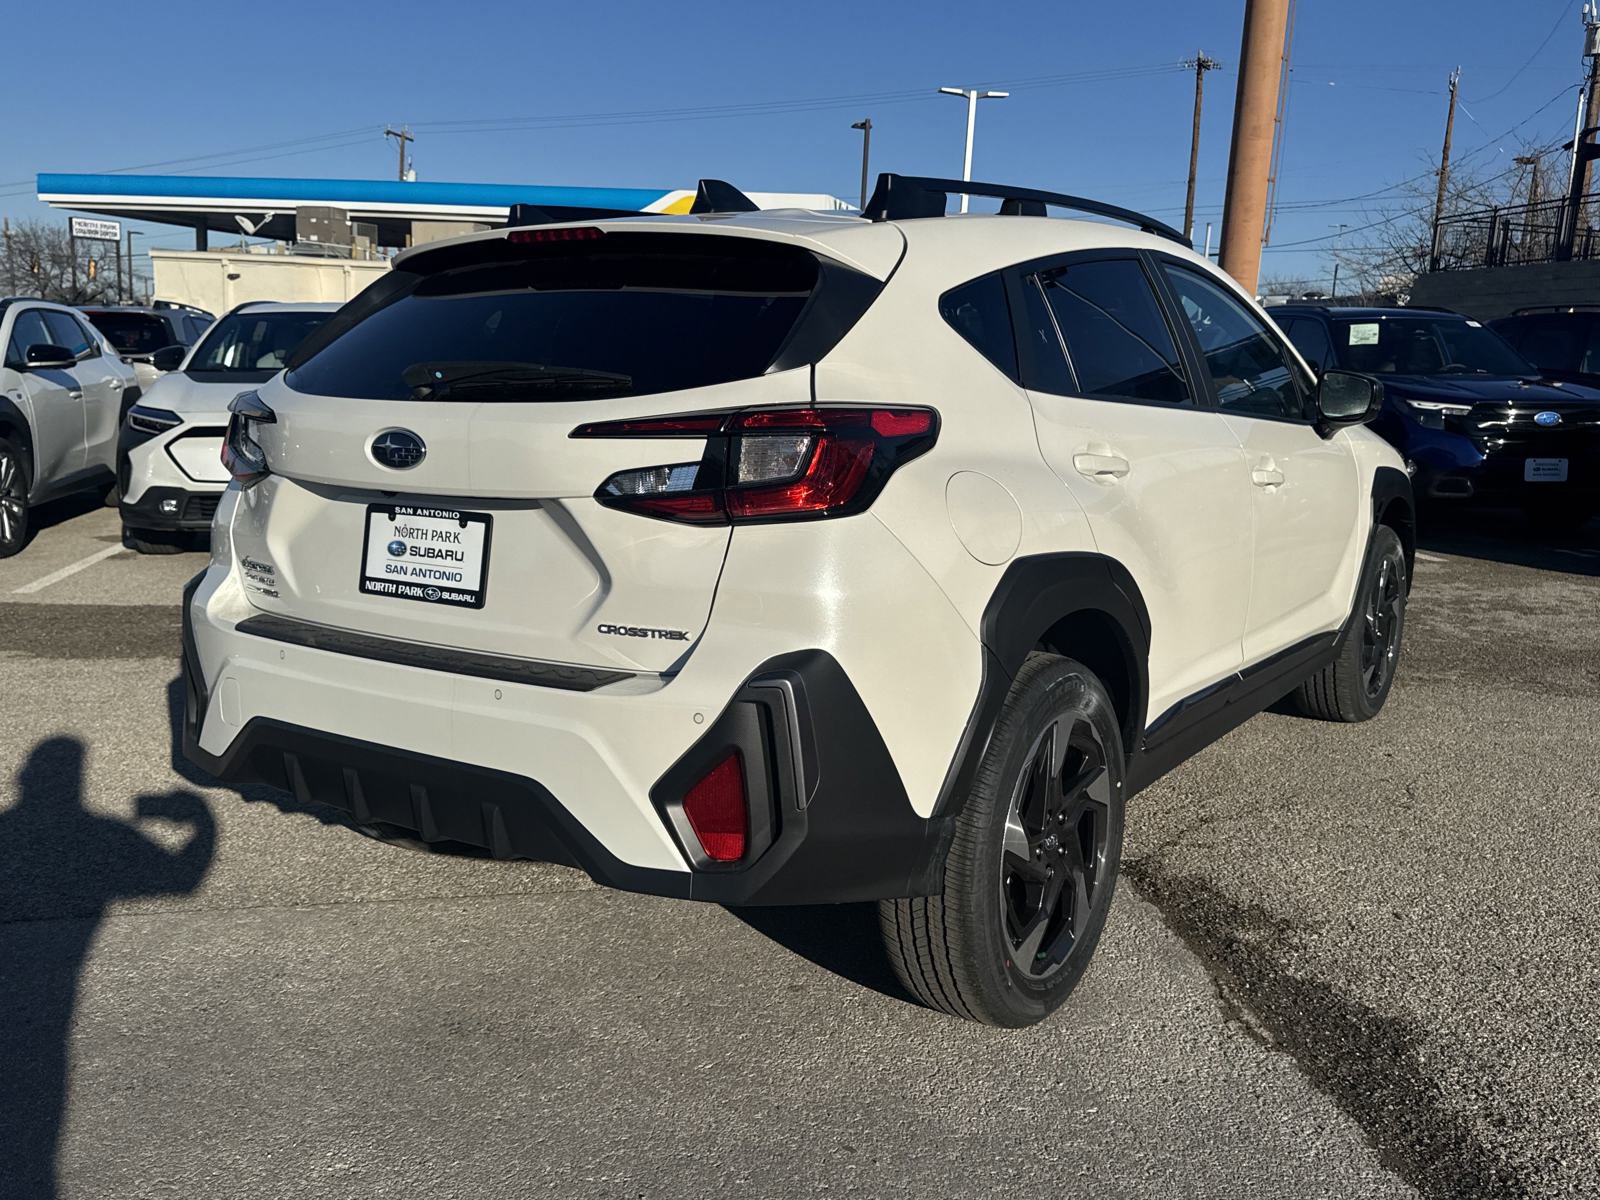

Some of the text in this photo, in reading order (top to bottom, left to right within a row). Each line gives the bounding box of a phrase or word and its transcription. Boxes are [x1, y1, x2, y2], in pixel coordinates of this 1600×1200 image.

[394, 506, 460, 519] SAN ANTONIO
[393, 524, 462, 544] NORTH PARK
[409, 545, 465, 562] SUBARU
[385, 564, 463, 583] SAN ANTONIO
[365, 580, 476, 603] NORTH PARK SUBARU
[597, 624, 690, 641] CROSSTREK
